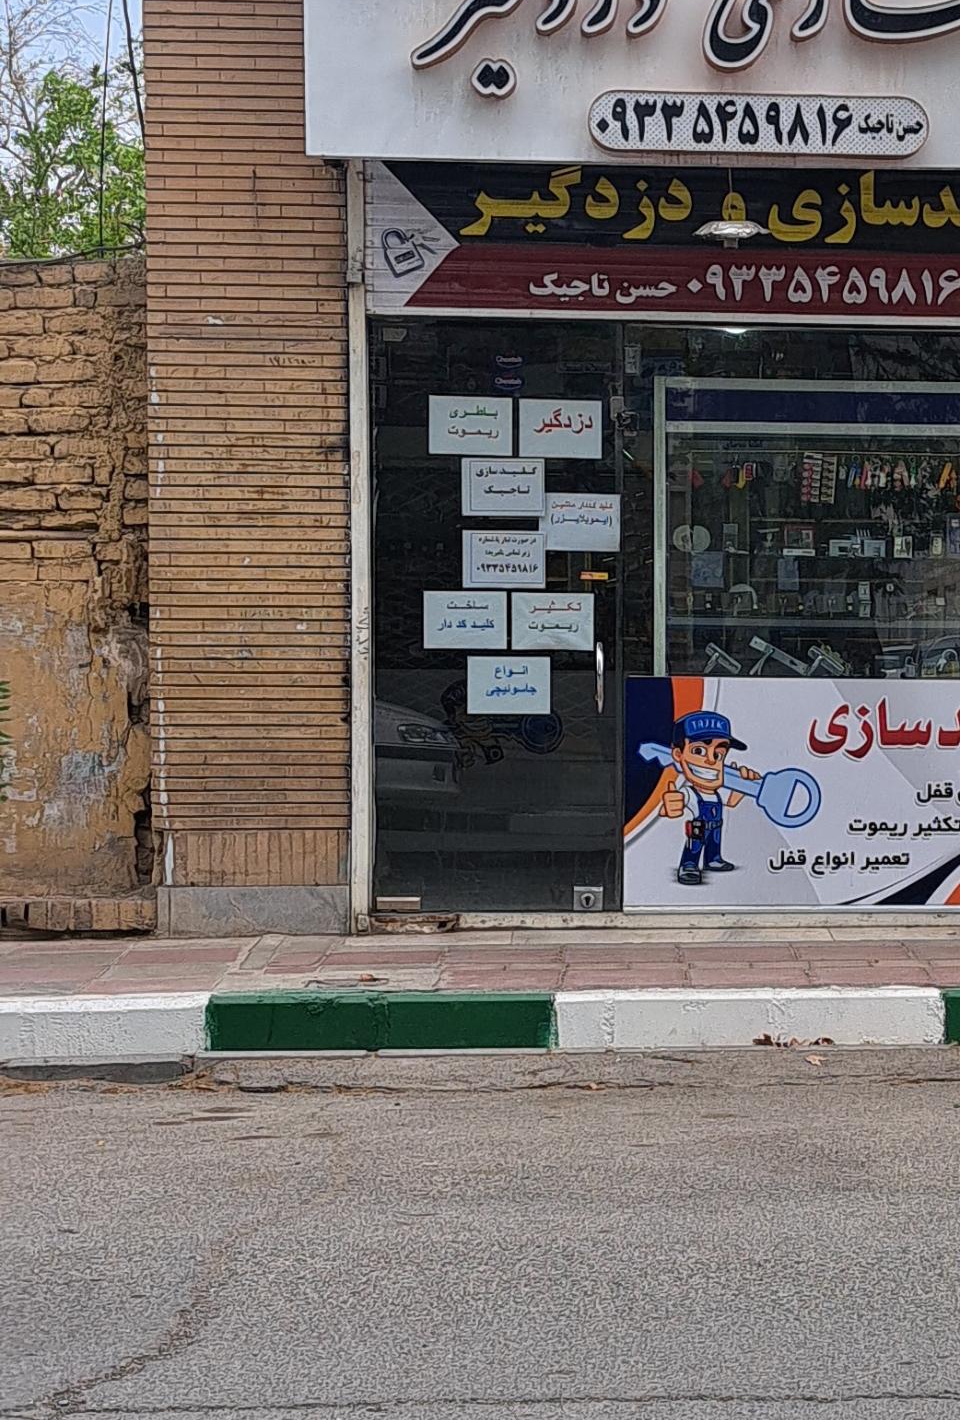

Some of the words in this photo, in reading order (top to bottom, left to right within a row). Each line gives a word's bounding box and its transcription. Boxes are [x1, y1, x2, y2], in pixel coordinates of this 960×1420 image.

[857, 112, 894, 142] تاجیک
[895, 117, 925, 142] حسن
[459, 165, 694, 241] دزدگیر
[527, 271, 612, 300] تاجیک
[614, 274, 679, 306] حسن
[449, 404, 499, 420] باطری
[533, 407, 594, 434] دزدگیر
[447, 426, 500, 440] ریموت
[483, 484, 531, 498] تاجیک
[446, 600, 489, 610] ساخت
[528, 599, 582, 614] تکثیر
[470, 618, 495, 631] کلید
[527, 621, 580, 632] ریموت
[494, 665, 529, 680] انواع
[915, 781, 953, 805] قفل
[848, 818, 908, 838] ریموت
[768, 849, 808, 873] قفل
[810, 850, 856, 876] انواع
[860, 851, 911, 871] تعمیر
